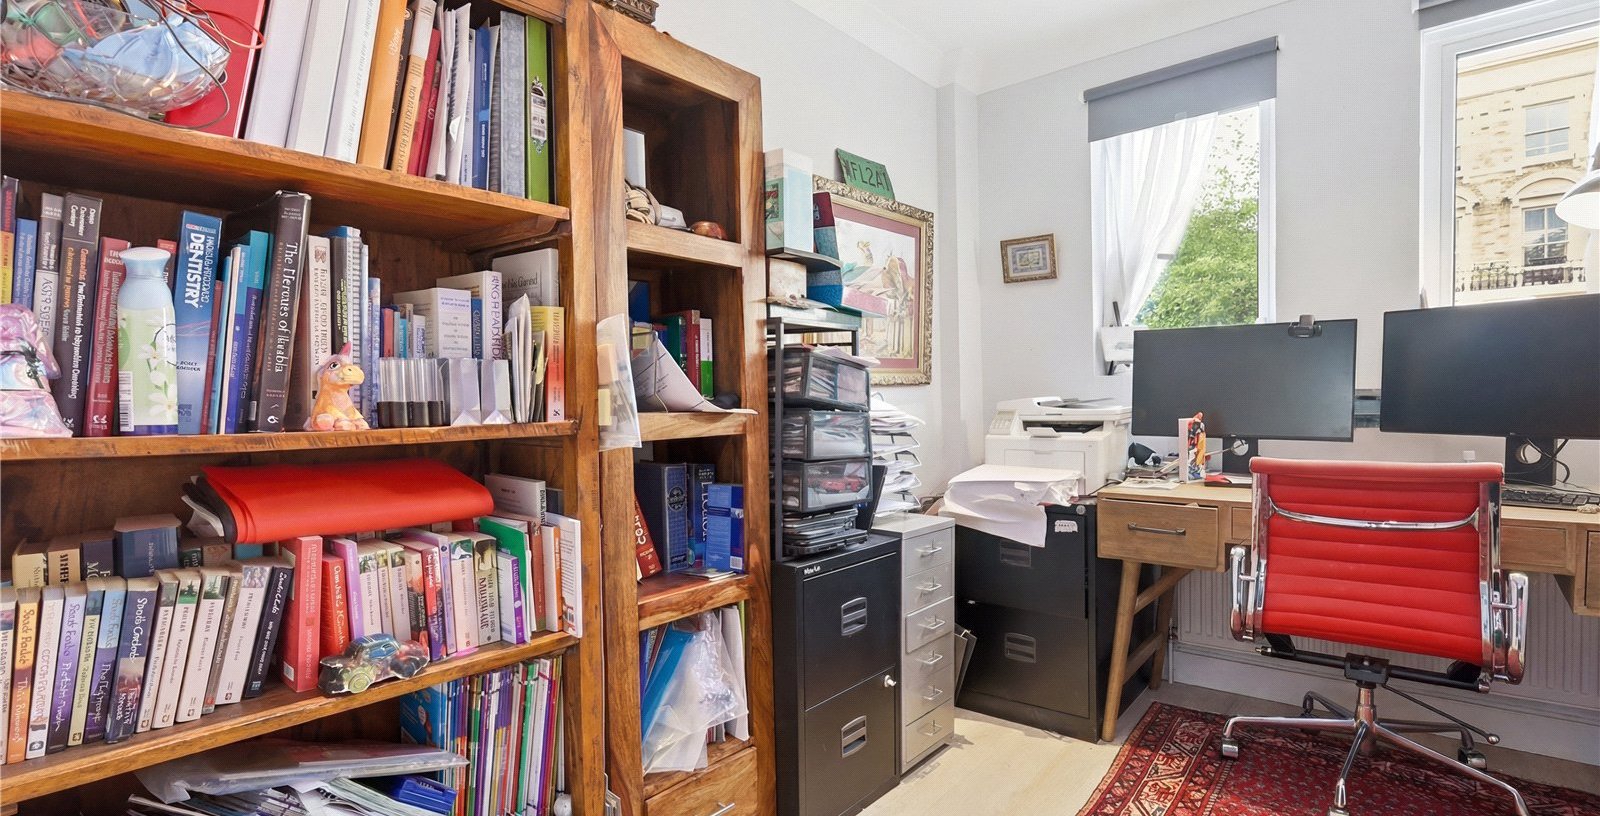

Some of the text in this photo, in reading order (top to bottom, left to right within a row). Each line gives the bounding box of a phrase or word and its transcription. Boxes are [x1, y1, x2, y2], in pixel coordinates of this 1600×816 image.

[285, 242, 299, 264] The
[184, 232, 205, 309] DENTISTRY
[278, 320, 291, 334] of
